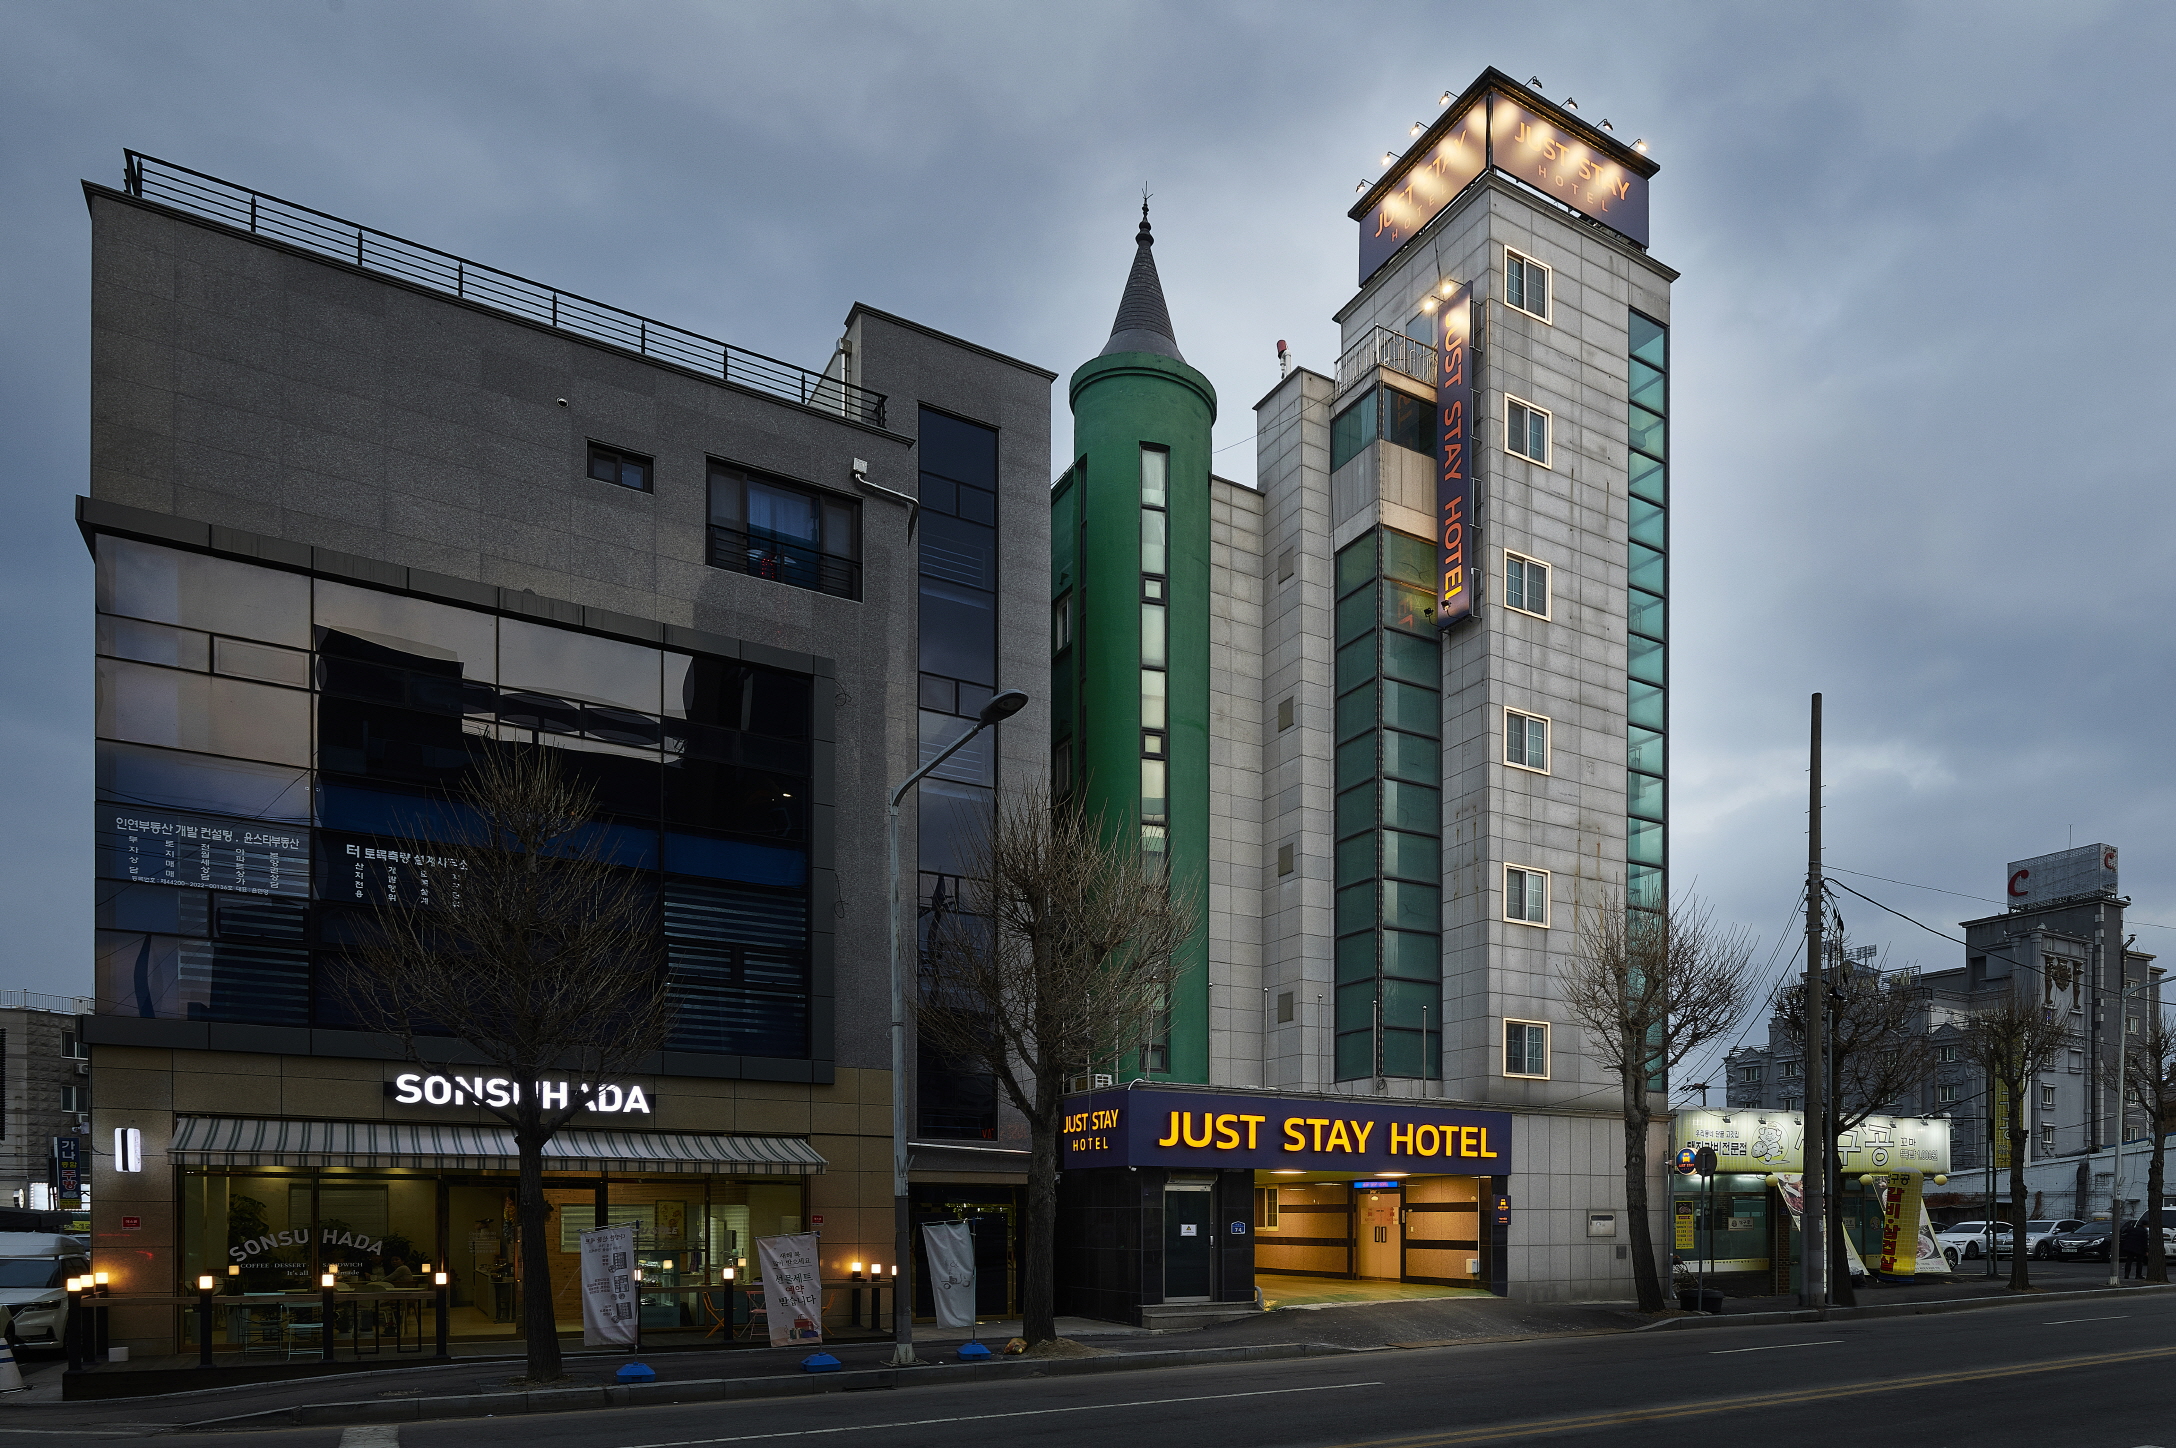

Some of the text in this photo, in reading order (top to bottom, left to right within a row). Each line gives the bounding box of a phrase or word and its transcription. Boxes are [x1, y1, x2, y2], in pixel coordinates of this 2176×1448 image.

[1514, 121, 1631, 201] JUST STAY
[1538, 165, 1609, 212] HOTEL
[1391, 184, 1447, 242] HOTEL
[1444, 400, 1463, 481] STAY
[1444, 495, 1463, 601] HOTEL
[115, 817, 300, 850] 인연부동산 개발 컨설팅 윤스타부동산
[346, 843, 360, 859] 터
[2008, 869, 2029, 897] C
[1063, 1108, 1119, 1134] JUST STAY
[1159, 1111, 1498, 1158] JUST STAY HOTEL
[1072, 1137, 1109, 1152] HOTEL
[229, 1228, 384, 1263] SONSU HADA
[775, 1272, 813, 1285] 선물세트
[785, 1284, 805, 1295] 예약
[778, 1294, 817, 1307] 받습니다
